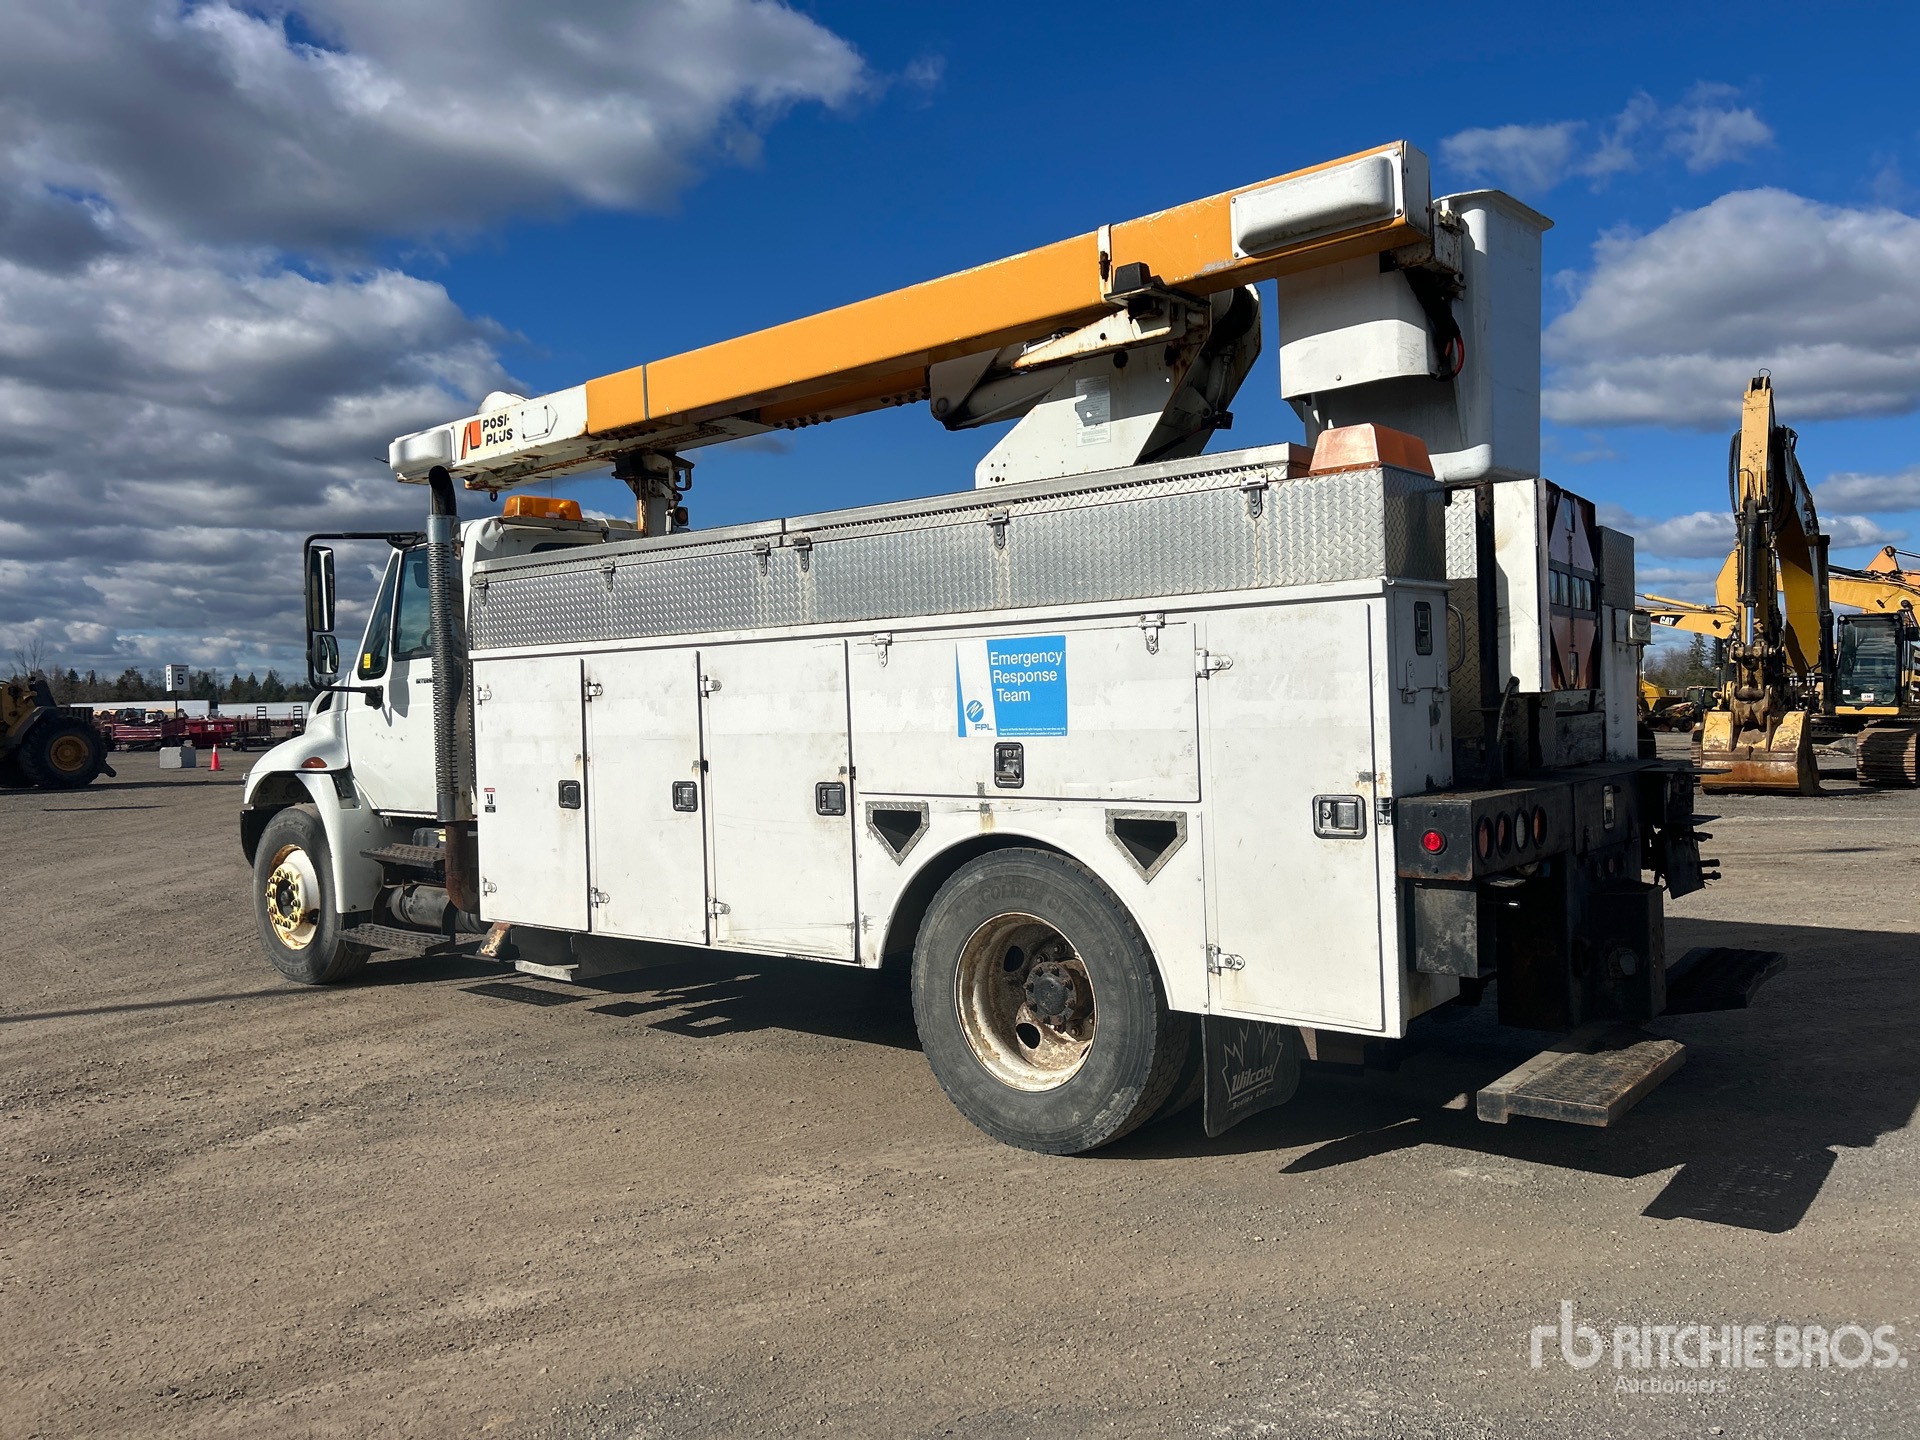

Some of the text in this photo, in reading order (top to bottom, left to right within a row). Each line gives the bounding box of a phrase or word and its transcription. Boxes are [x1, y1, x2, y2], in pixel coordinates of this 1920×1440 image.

[486, 428, 513, 446] PLUS
[1660, 615, 1675, 626] CAT
[990, 650, 1064, 668] Emergency
[176, 673, 185, 686] 5
[993, 669, 1058, 687] Response
[996, 687, 1031, 702] Team
[974, 723, 993, 731] FPL
